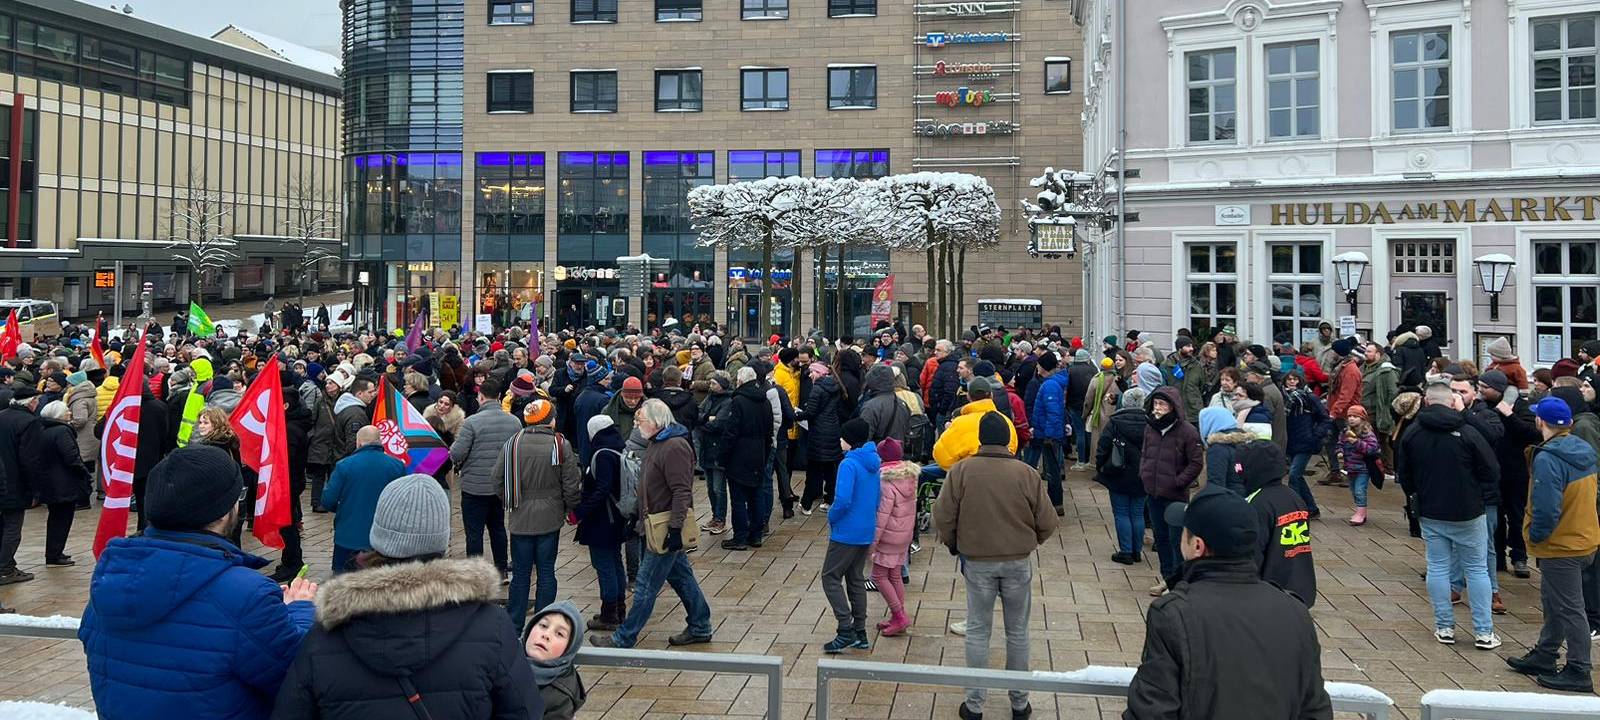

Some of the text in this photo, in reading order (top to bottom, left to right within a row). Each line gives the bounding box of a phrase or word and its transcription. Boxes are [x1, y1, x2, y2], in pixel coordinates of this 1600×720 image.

[949, 3, 985, 14] SINN
[1270, 196, 1600, 226] HULDA AM MARKT
[1040, 238, 1070, 250] HAUS
